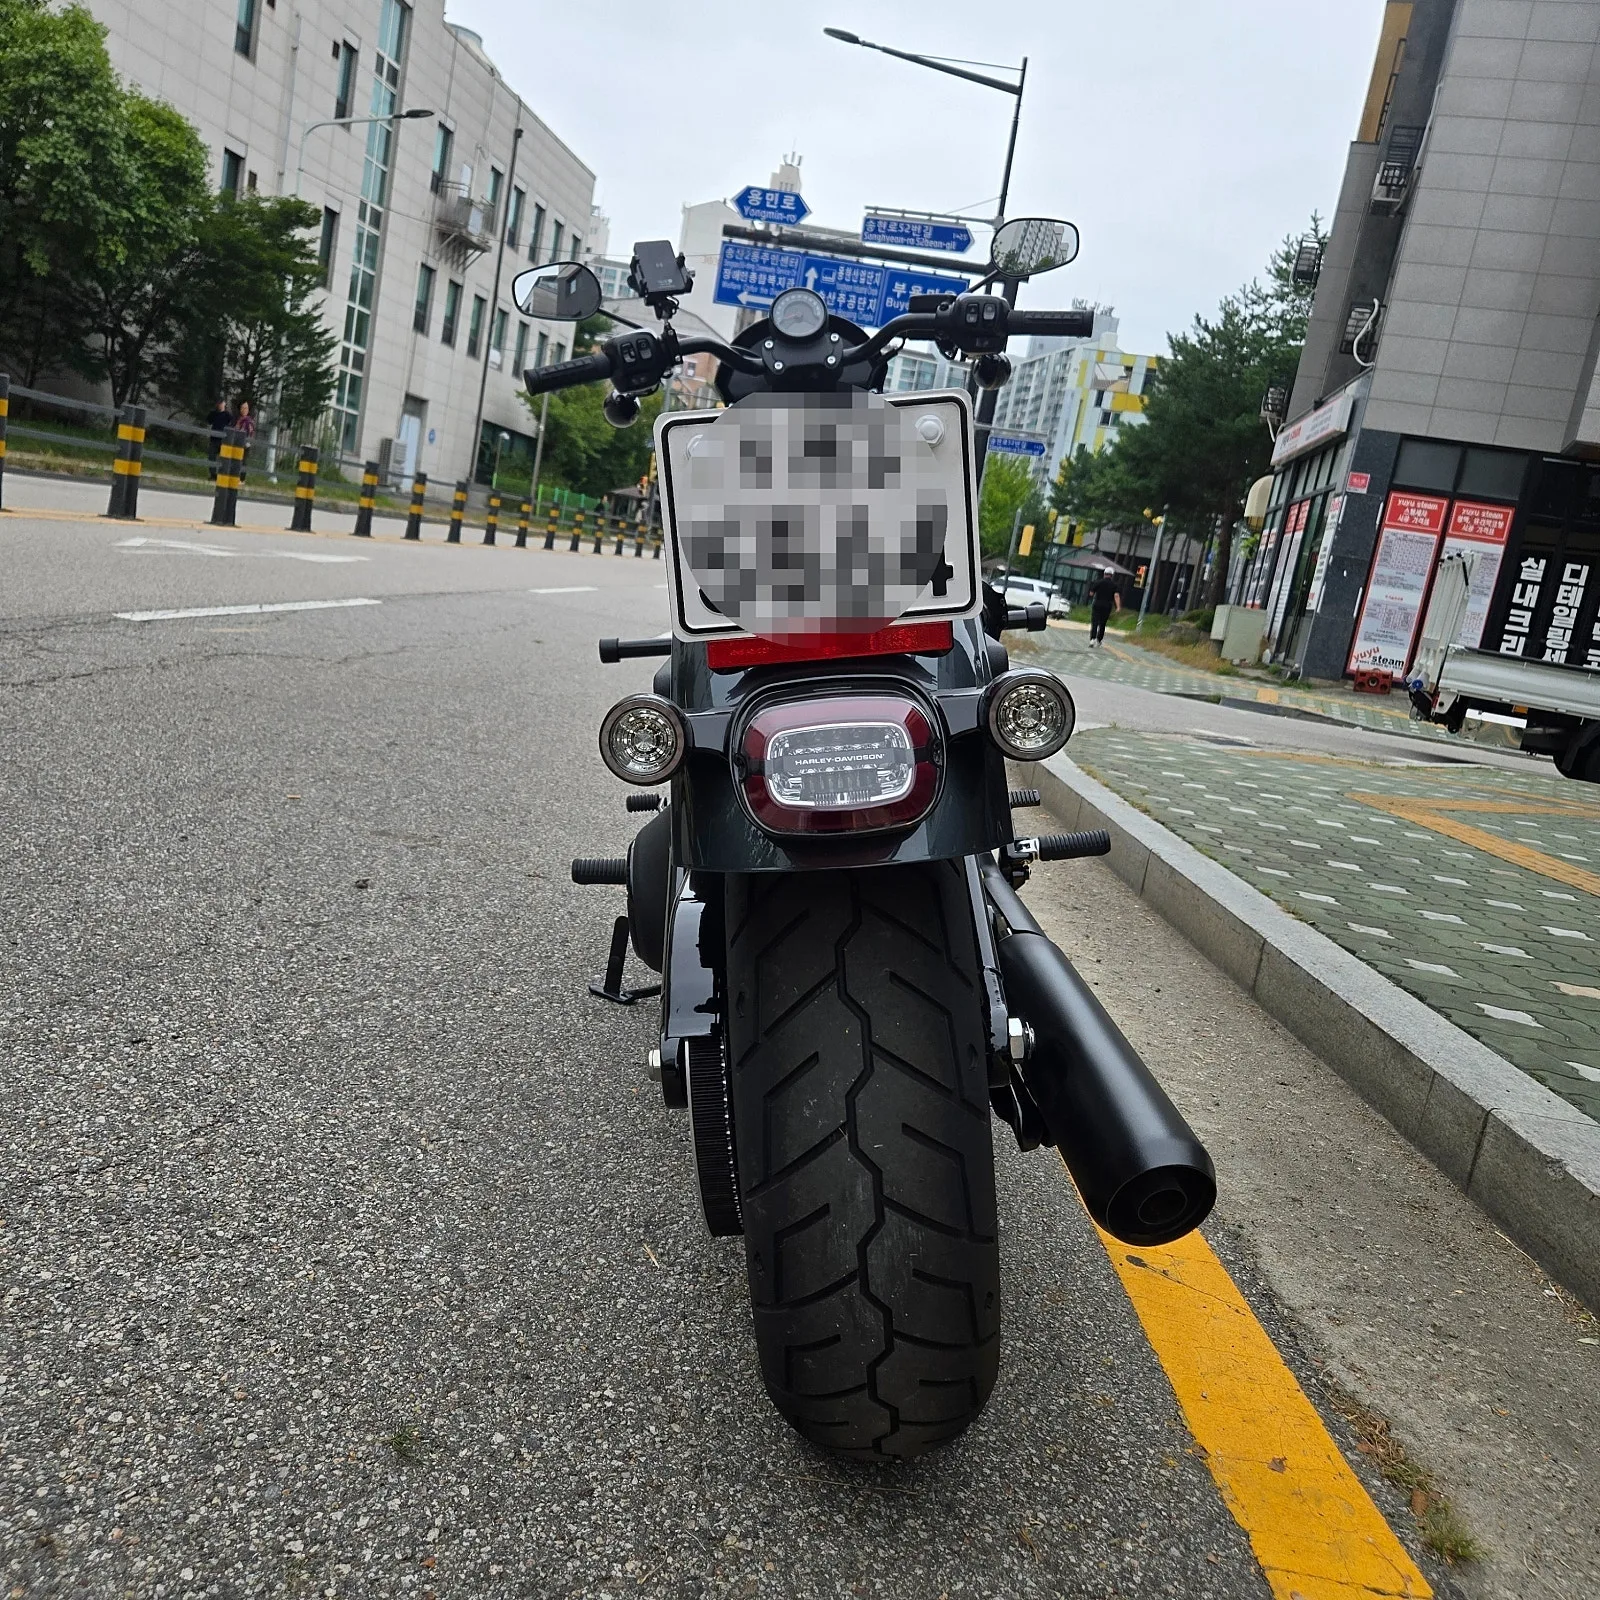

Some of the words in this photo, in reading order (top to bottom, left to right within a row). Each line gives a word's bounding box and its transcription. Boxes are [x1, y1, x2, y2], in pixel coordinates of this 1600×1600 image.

[747, 188, 797, 211] 용민로
[743, 205, 797, 223] Yongmin-ro
[725, 246, 799, 269] 송산2동주민센터
[722, 267, 796, 289] 장애인종합복지관
[1353, 646, 1380, 663] yuyu
[1371, 654, 1405, 667] steam
[795, 753, 884, 765] HARLEY-DAVIDSON
